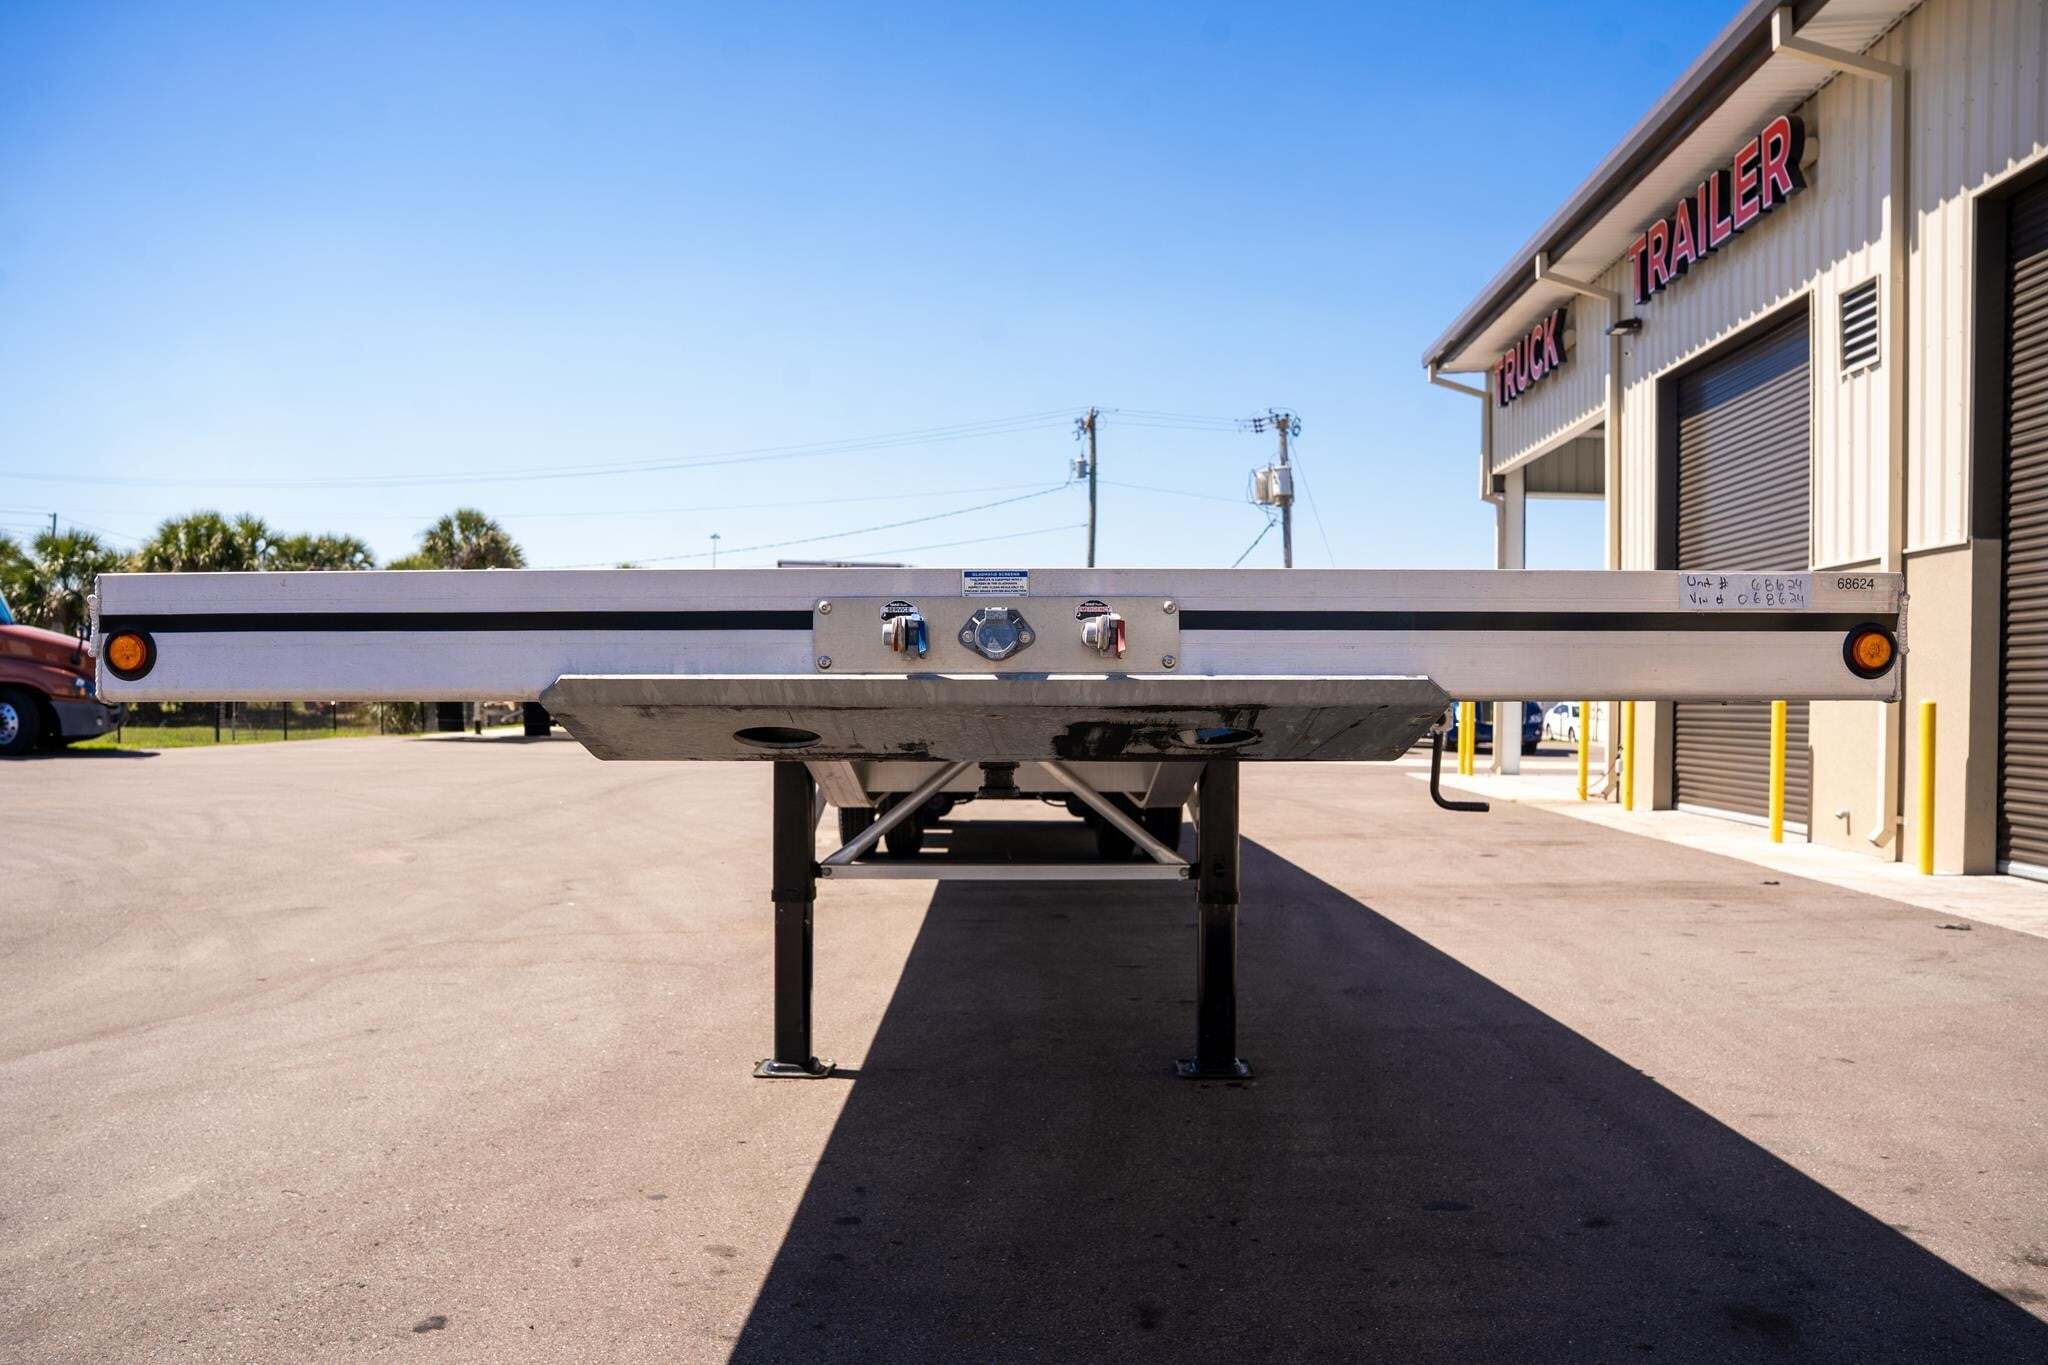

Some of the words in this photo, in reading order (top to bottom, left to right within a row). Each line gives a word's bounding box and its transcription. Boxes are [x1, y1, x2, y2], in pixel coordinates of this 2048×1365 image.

[1628, 115, 1795, 304] TRAILER
[1494, 308, 1562, 407] TRUCK
[1687, 575, 1712, 588] Unit
[1720, 576, 1728, 590] #
[1837, 577, 1874, 590] 68624
